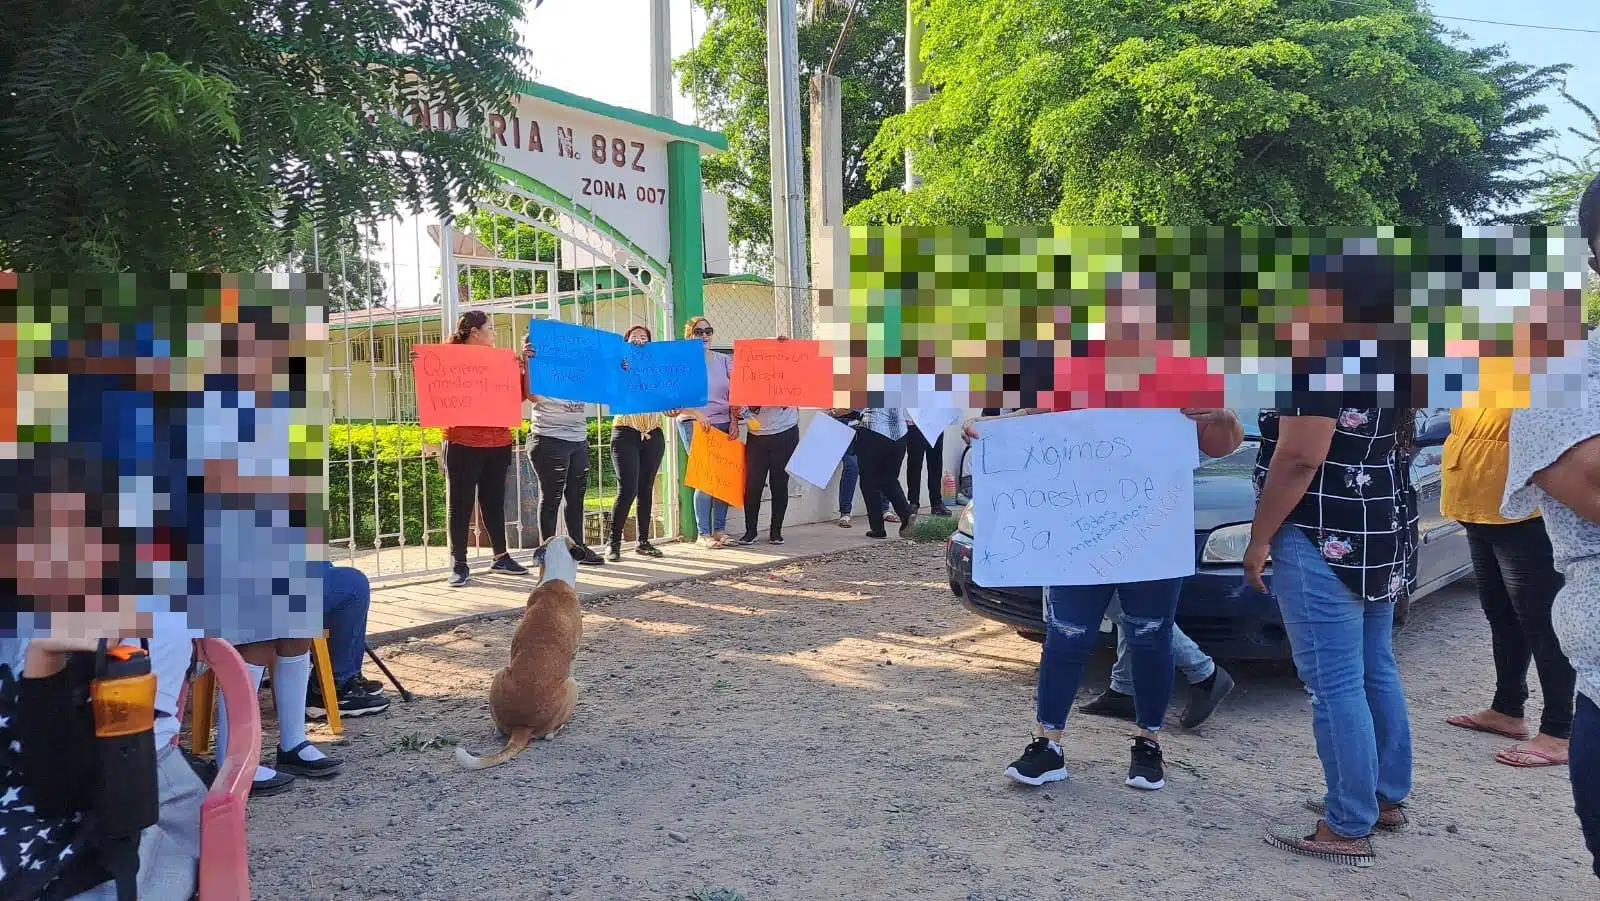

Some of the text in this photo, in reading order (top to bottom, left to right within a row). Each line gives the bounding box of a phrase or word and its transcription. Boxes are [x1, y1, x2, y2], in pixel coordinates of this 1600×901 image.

[581, 177, 666, 205] ZONA 007
[979, 434, 1133, 481] Exigimos
[991, 480, 1108, 513] maestro
[1070, 510, 1118, 533] Todos
